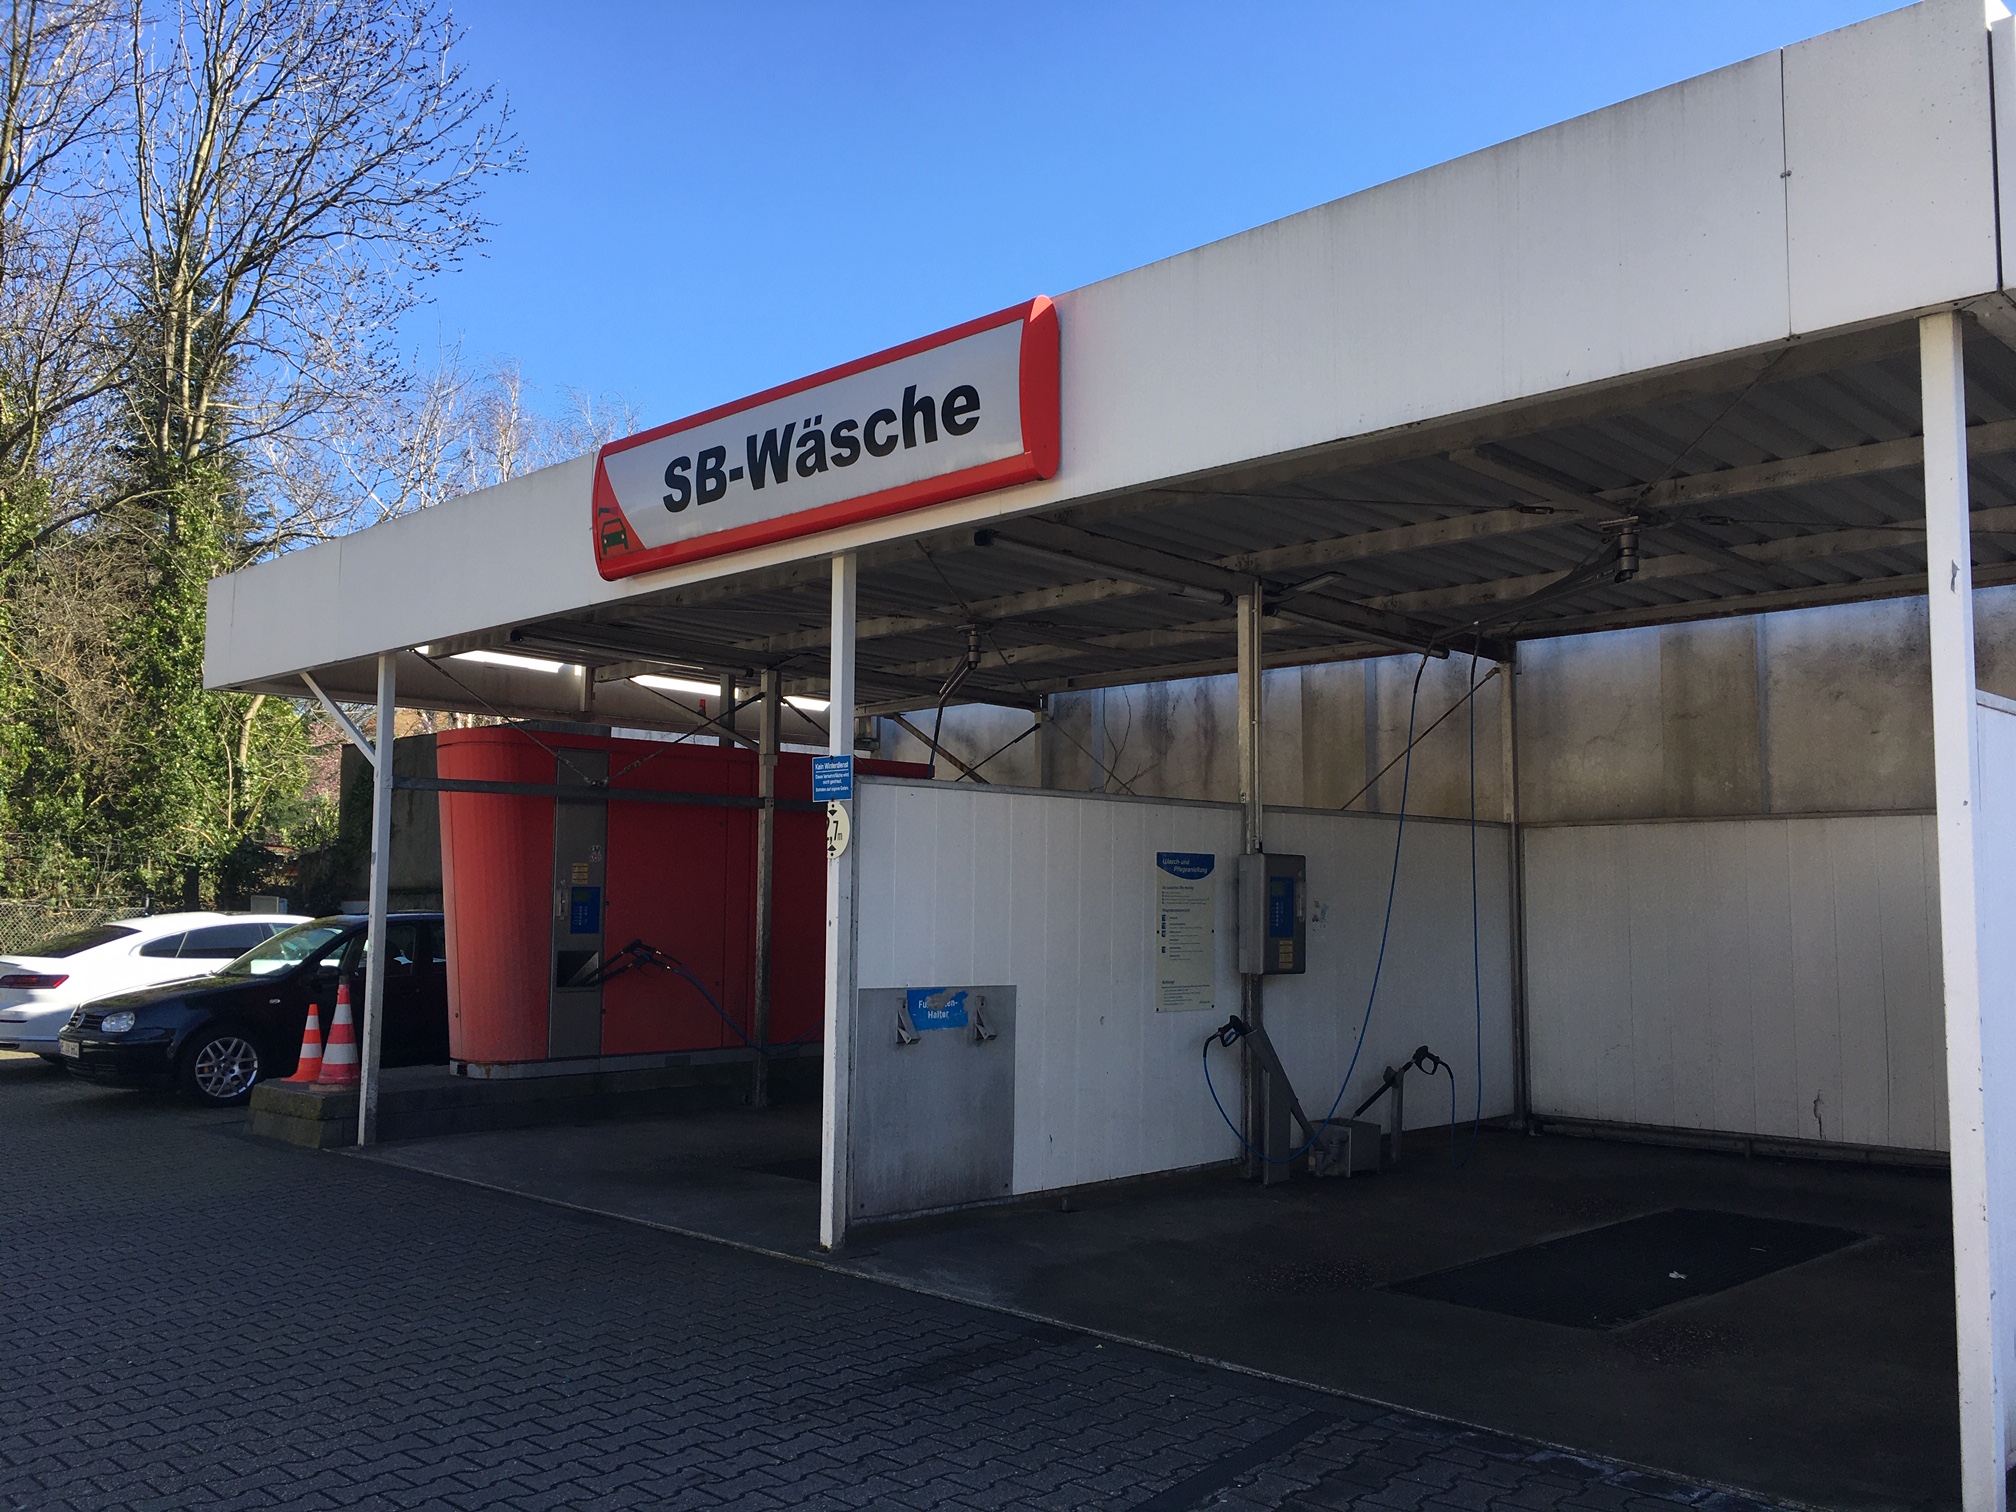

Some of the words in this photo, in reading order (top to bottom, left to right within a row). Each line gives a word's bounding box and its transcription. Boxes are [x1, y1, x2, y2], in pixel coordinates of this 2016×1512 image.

[662, 384, 981, 513] SB-Wäsche
[824, 761, 849, 769] Winterdienst
[927, 1010, 949, 1019] Halter
